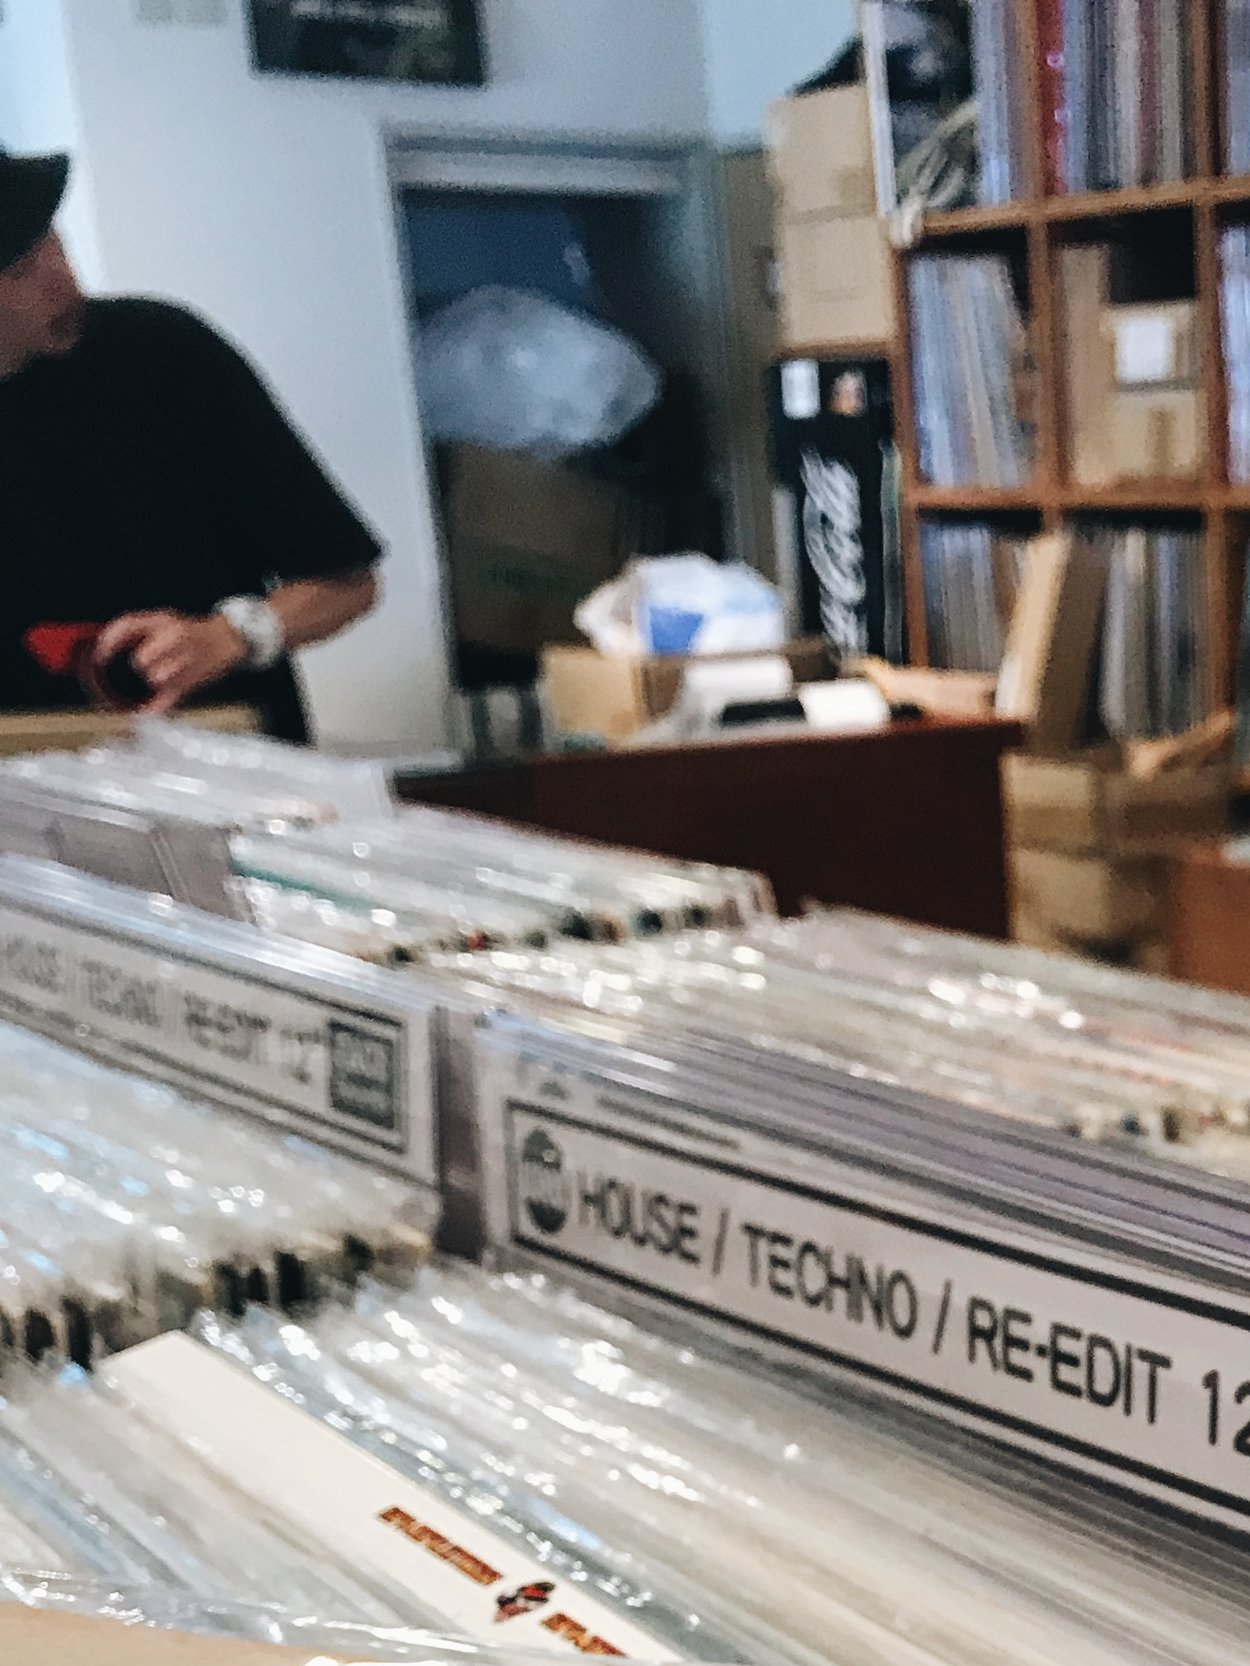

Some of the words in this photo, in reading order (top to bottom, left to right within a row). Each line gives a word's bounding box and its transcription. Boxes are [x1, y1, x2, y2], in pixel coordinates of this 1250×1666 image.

[576, 1168, 700, 1263] HOUSE
[712, 1207, 730, 1277] /
[741, 1222, 918, 1339] TECHNO
[932, 1279, 953, 1354] /
[966, 1296, 1172, 1424] RE-EDIT
